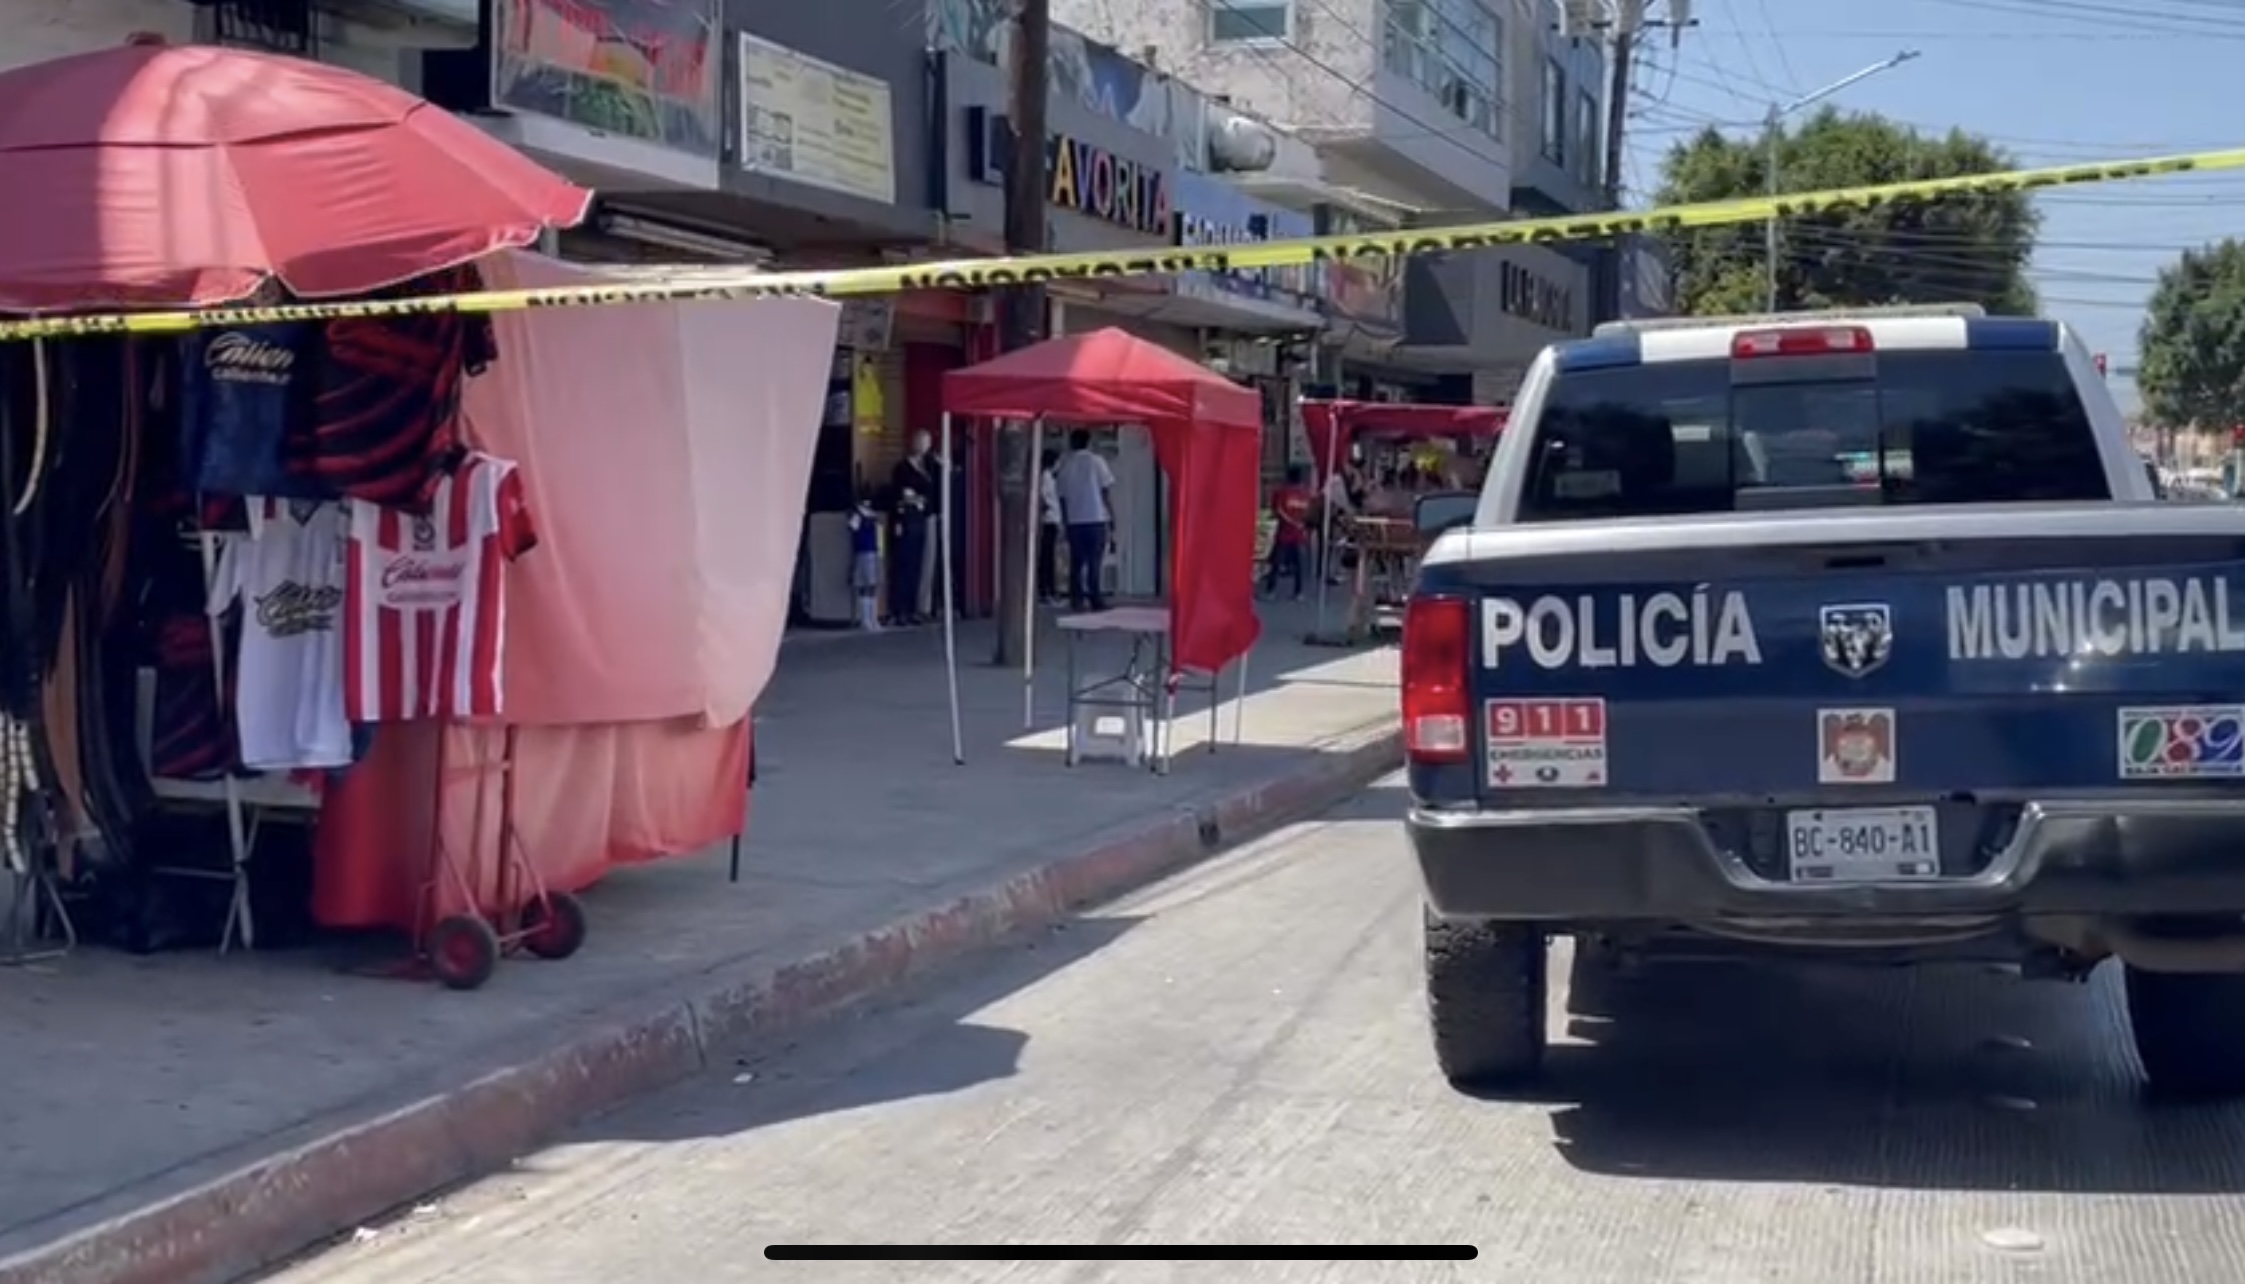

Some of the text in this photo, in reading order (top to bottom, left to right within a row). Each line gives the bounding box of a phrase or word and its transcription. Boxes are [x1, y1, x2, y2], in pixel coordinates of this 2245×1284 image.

[1047, 133, 1170, 236] AVORITA
[1481, 577, 2245, 669] POLICÍA MUNICIPAL
[1495, 706, 1591, 734] 911
[2126, 713, 2242, 766] 089
[1794, 823, 1930, 858] BC-840-A1
